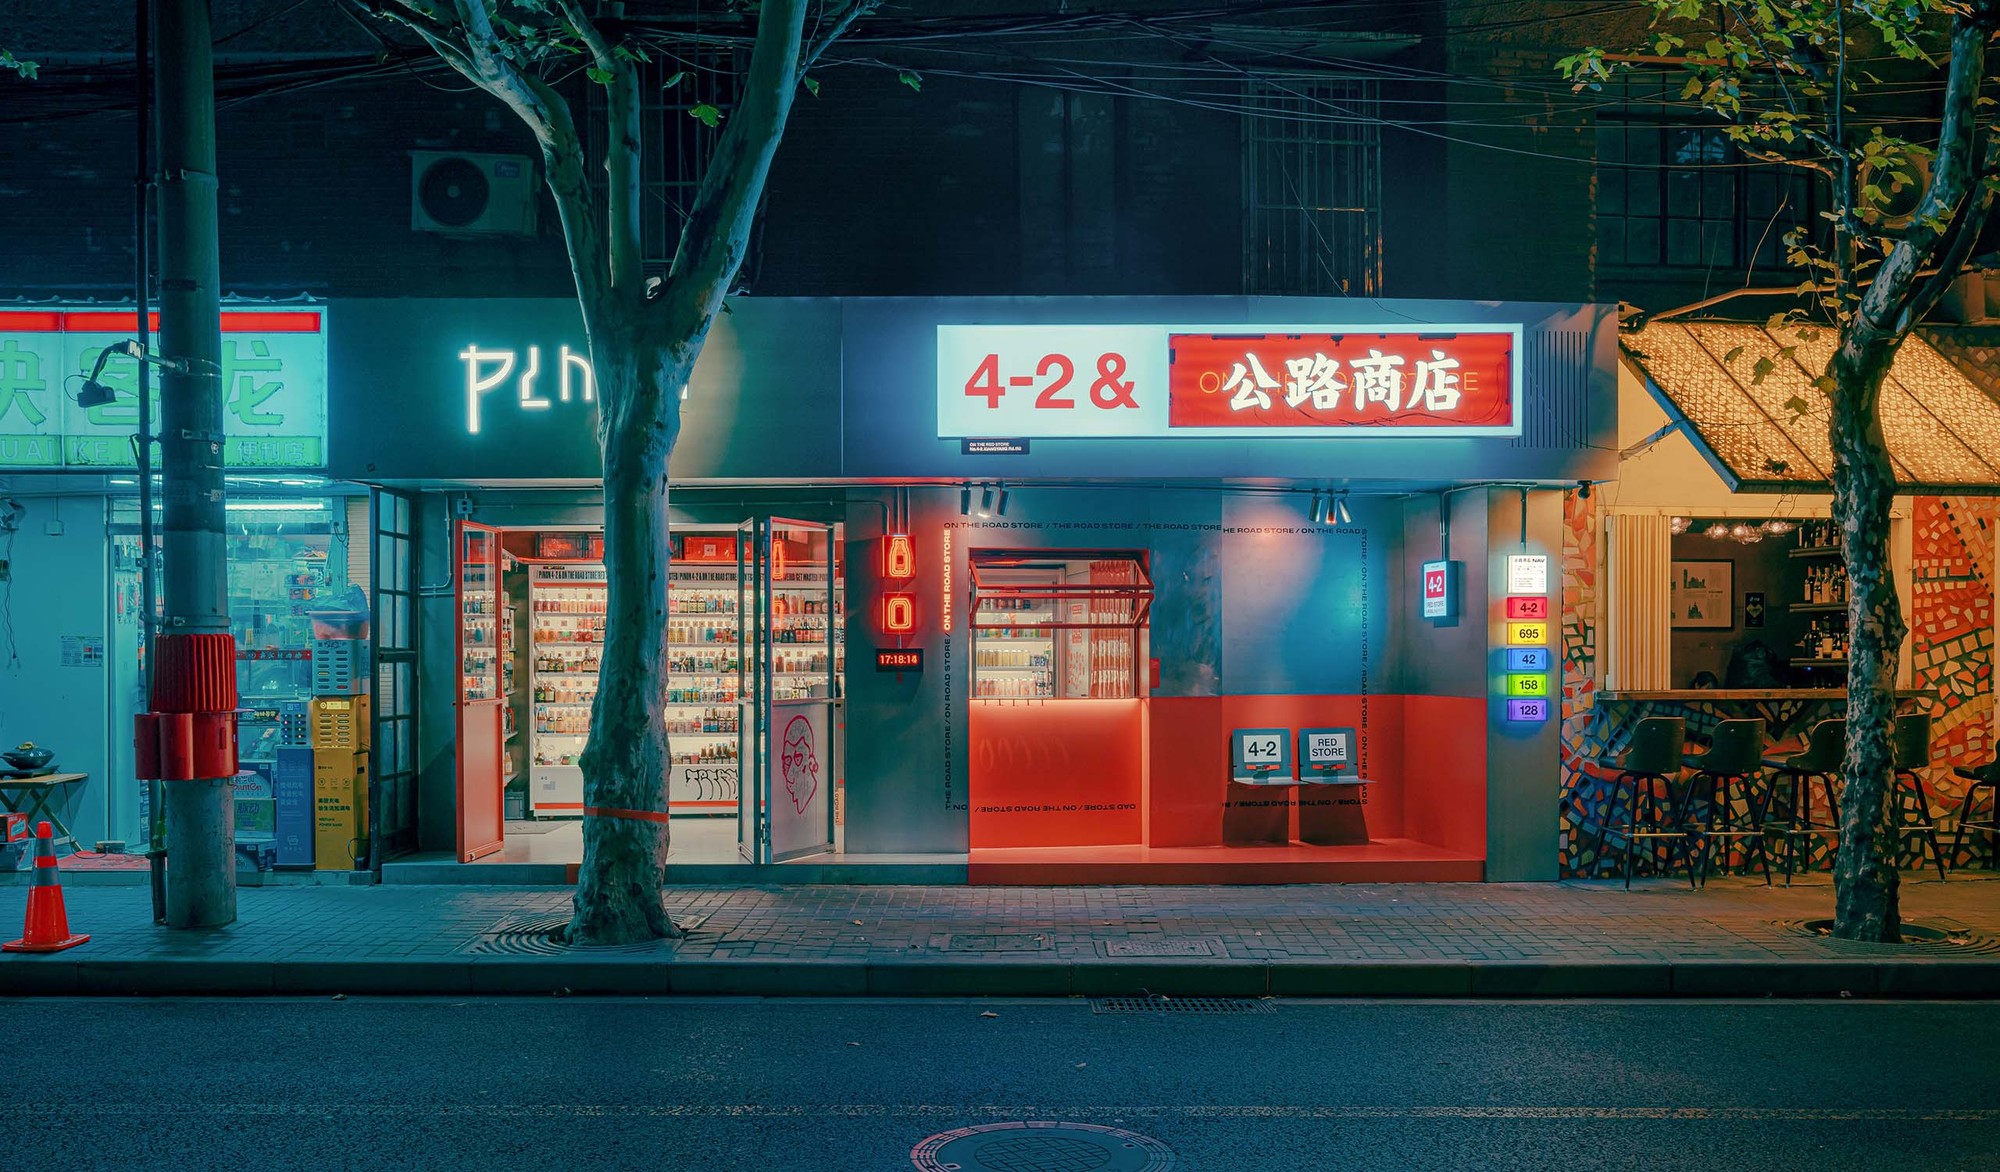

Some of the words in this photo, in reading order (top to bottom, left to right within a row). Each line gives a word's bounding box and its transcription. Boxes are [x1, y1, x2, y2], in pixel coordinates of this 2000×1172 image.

[964, 354, 1075, 409] 4-2
[1089, 353, 1140, 410] &
[1221, 350, 1462, 413] 公路商店
[943, 529, 951, 563] STORE
[943, 564, 951, 592] ROAD
[1361, 567, 1367, 581] ON
[1428, 575, 1443, 592] 4-2
[943, 593, 951, 614] THE
[1520, 602, 1538, 613] 4-2
[943, 616, 951, 631] ON
[1519, 628, 1539, 639] 695
[1522, 654, 1536, 664] 42
[1519, 680, 1538, 690] 158
[944, 703, 951, 718] ON
[1519, 705, 1538, 716] 128
[1248, 741, 1277, 756] 4-2
[1318, 738, 1338, 746] RED
[1361, 737, 1367, 750] ON
[1312, 748, 1344, 757] STORE
